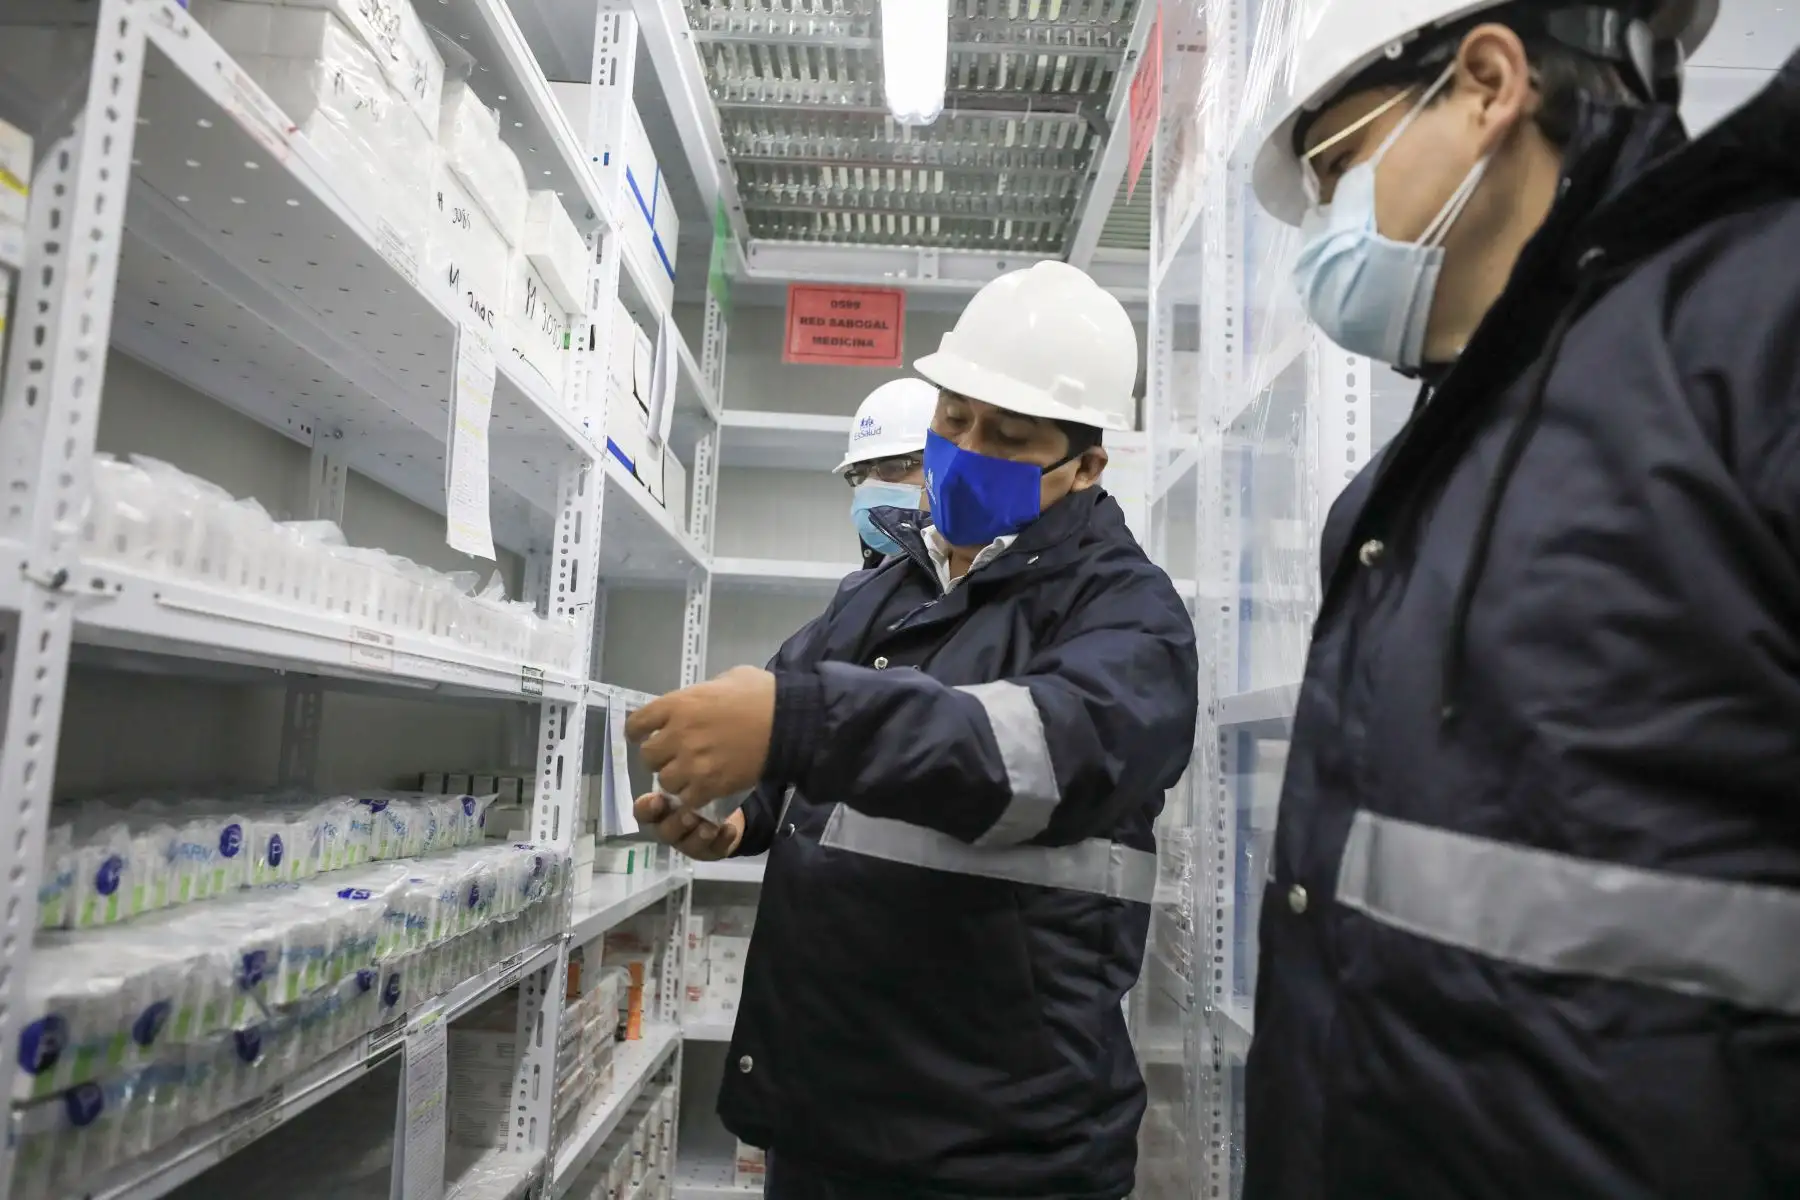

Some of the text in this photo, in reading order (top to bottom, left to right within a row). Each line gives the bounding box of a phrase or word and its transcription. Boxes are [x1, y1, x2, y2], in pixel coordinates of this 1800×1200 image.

[800, 317, 889, 330] RED SABOGAL
[812, 336, 876, 348] MEDICINA
